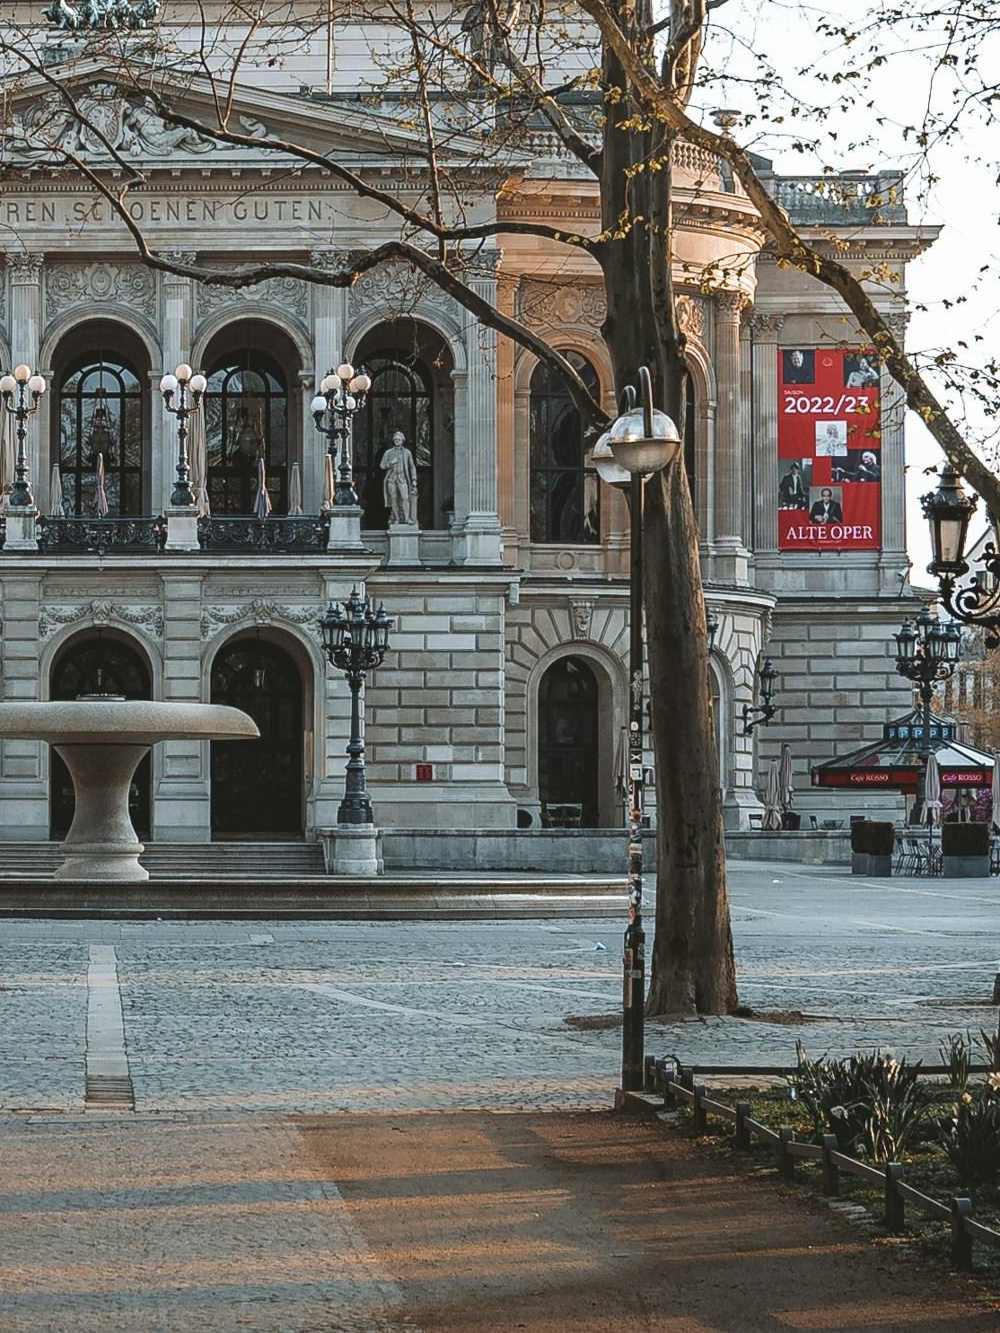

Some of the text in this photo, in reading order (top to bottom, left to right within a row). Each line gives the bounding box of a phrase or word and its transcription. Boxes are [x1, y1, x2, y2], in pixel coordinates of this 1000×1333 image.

[234, 201, 332, 221] GUTEN.
[784, 394, 869, 416] 2022/23
[786, 525, 873, 540] ALTE OPER
